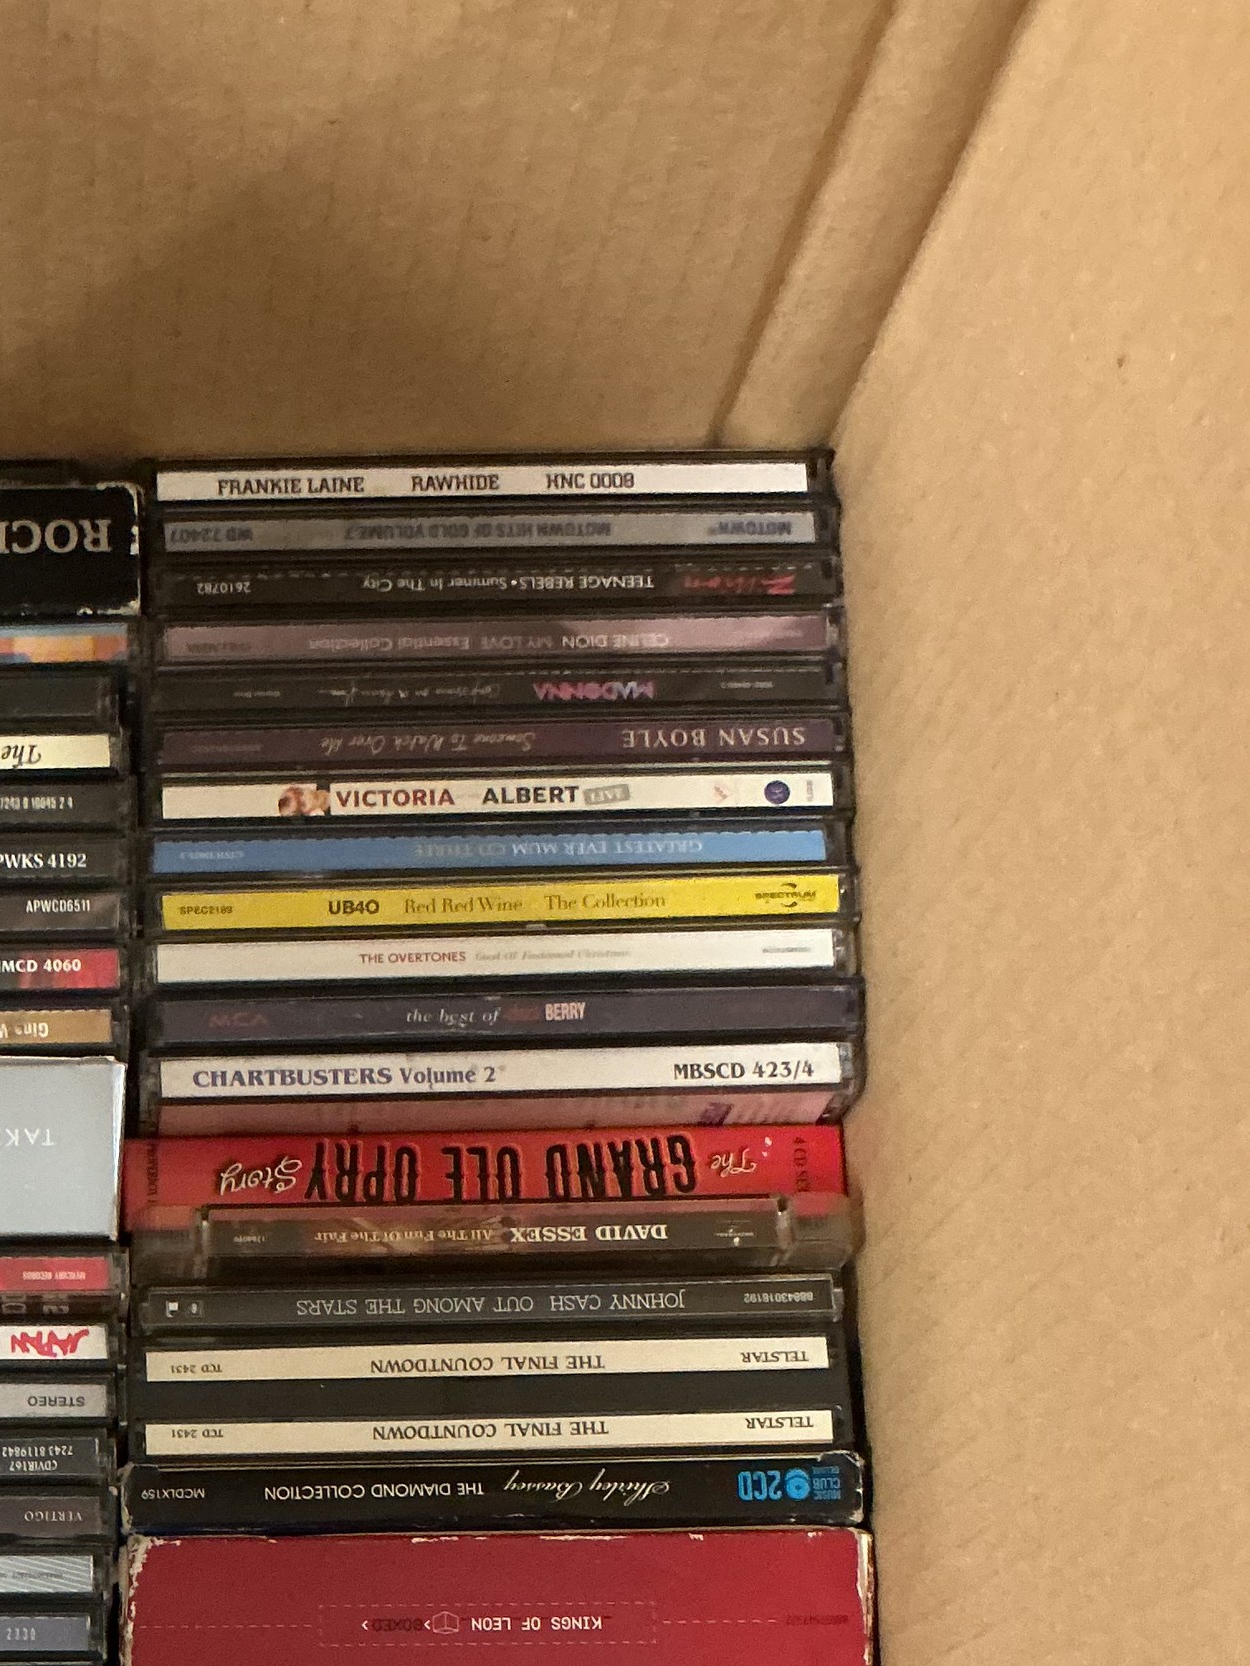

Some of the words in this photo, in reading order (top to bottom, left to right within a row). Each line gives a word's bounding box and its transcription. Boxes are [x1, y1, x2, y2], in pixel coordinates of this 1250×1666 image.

[218, 478, 301, 496] FRANKIE
[308, 477, 364, 493] LAINE
[412, 474, 499, 491] RAWHIDE
[546, 473, 584, 489] HNC
[336, 789, 455, 807] VICTORIA
[483, 786, 579, 804] ALBERT
[48, 854, 86, 868] 4192
[26, 900, 90, 913] APWCD6511
[329, 900, 379, 914] UB40
[359, 954, 383, 963] THE
[388, 952, 466, 963] OVERTONES
[44, 959, 81, 972] 4060
[674, 1063, 745, 1079] MBSCD
[753, 1061, 814, 1080] 423/4
[193, 1068, 392, 1087] CHARTBUSTERS
[400, 1068, 476, 1090] Volume
[484, 1067, 495, 1082] 2
[501, 1356, 558, 1370] FINAL
[566, 1356, 605, 1369] THE
[741, 1351, 809, 1363] TELSTAR
[371, 1358, 493, 1373] COUNTDOWN
[28, 1396, 85, 1407] STEREO
[472, 1617, 511, 1630] LEON
[522, 1617, 540, 1630] OF
[551, 1616, 601, 1630] KINGS
